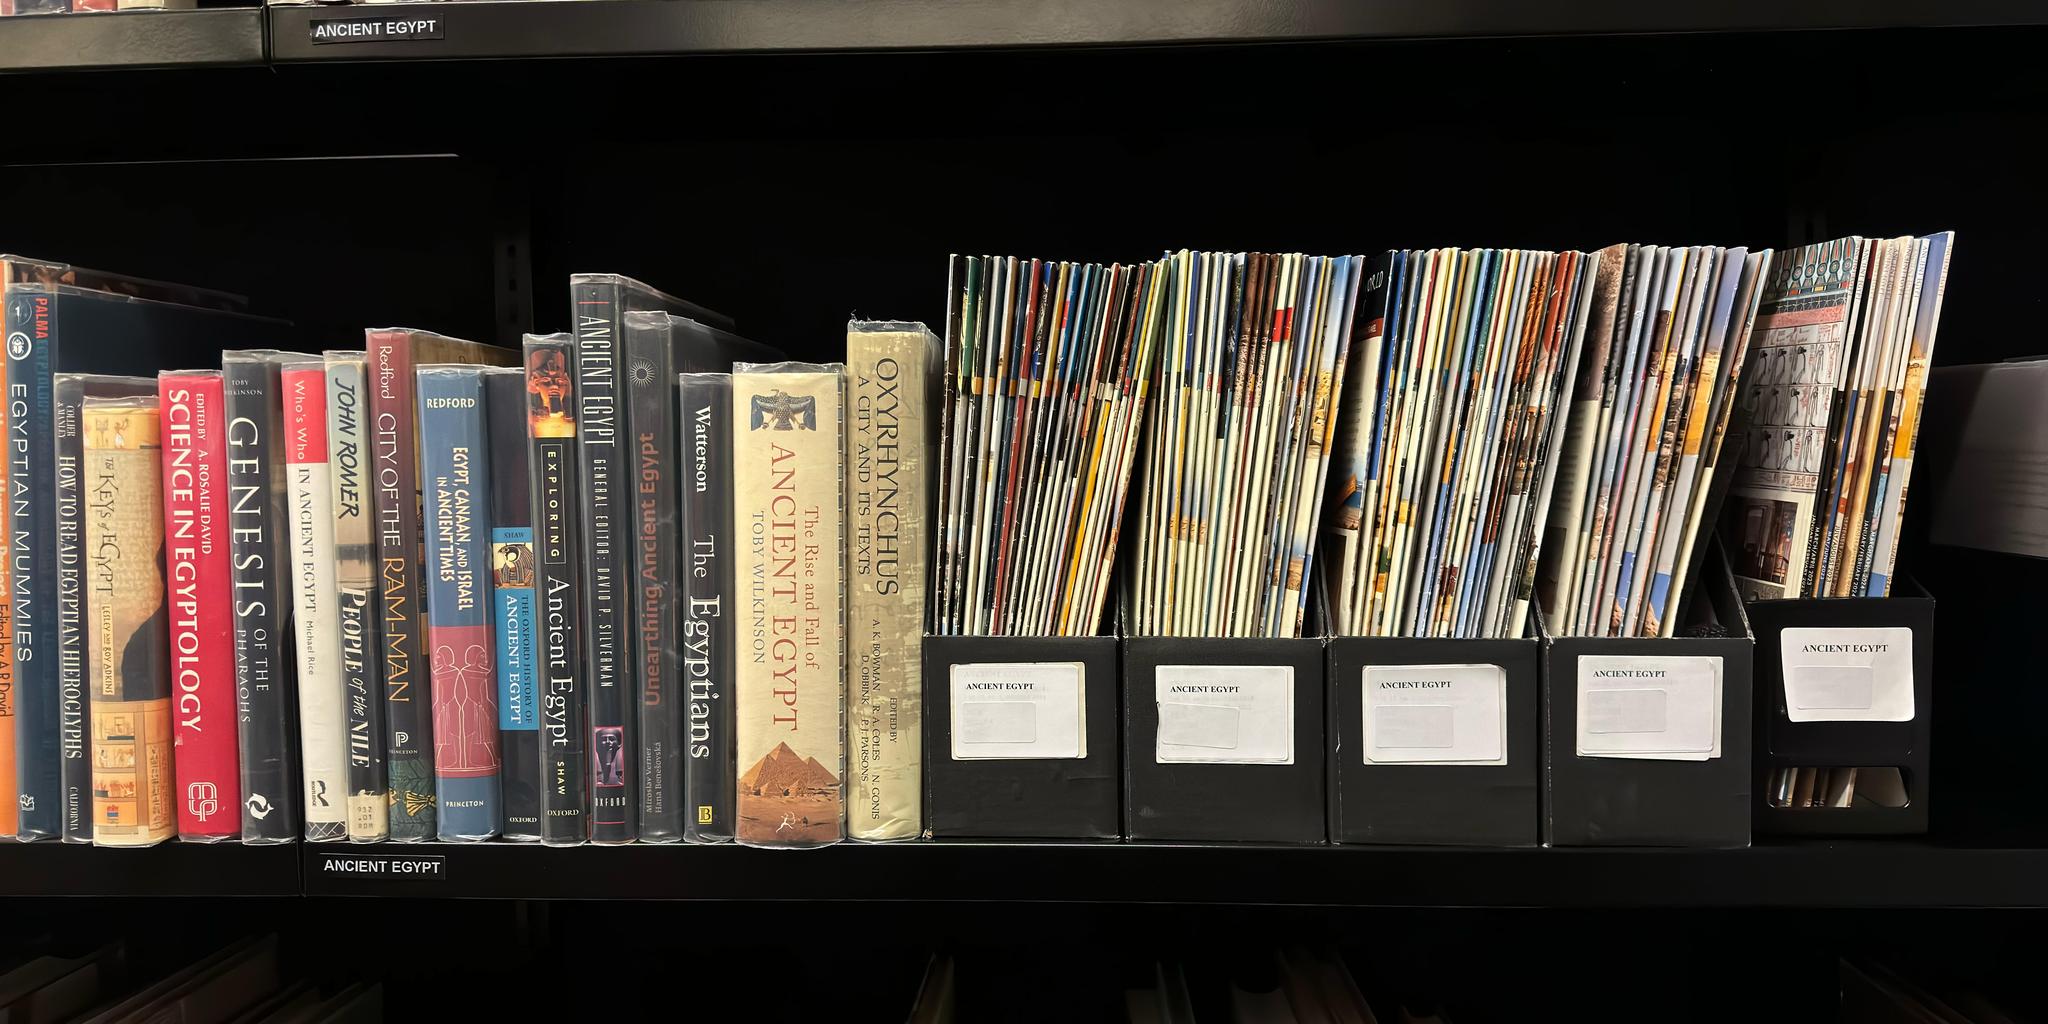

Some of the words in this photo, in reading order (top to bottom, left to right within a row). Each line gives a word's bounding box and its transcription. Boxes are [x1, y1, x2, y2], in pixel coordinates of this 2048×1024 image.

[315, 22, 382, 37] ANCIENT
[386, 20, 436, 35] EGYPT
[35, 298, 48, 339] PALMA
[379, 345, 396, 399] Redford
[580, 315, 613, 389] ANCIENT
[294, 380, 306, 423] Who's
[858, 376, 870, 388] A
[65, 405, 76, 437] COLLIER
[196, 393, 206, 427] EDITED
[335, 378, 356, 436] JOHN
[427, 398, 475, 408] REDFORD
[582, 396, 615, 448] EGYPT
[858, 396, 871, 435] CITY
[12, 384, 30, 517] EGYPTIAN
[168, 389, 193, 502] SCIENCE
[198, 429, 207, 441] BY
[198, 449, 209, 461] A.
[296, 427, 308, 460] Who
[378, 413, 398, 465] CITY
[695, 405, 711, 492] Watterson
[59, 456, 77, 491] HOW
[298, 468, 310, 484] IN
[336, 441, 360, 520] ROMER
[436, 477, 447, 487] IN
[452, 447, 469, 487] EGYPT,
[594, 459, 608, 507] GENERAL
[639, 433, 660, 493] Egypt
[858, 443, 871, 483] AND
[876, 357, 899, 596] OXYRHYNCHUS
[90, 474, 119, 518] KEYS
[199, 464, 211, 513] ROSALIE
[380, 468, 399, 500] OF
[547, 451, 560, 557] EXPLORING
[858, 492, 871, 516] ITS
[60, 495, 77, 519] TO
[173, 510, 195, 538] IN
[228, 417, 266, 617] GENESIS
[299, 489, 314, 558] ANCIENT
[382, 503, 401, 547] THE
[437, 489, 452, 548] ANCIENT
[453, 489, 471, 545] CANAAN,
[771, 442, 798, 604] ANCIENT
[804, 506, 820, 538] The
[60, 521, 78, 564] READ
[201, 515, 212, 554] DAVID
[595, 515, 610, 561] EDITOR:
[641, 499, 661, 578] Ancient
[752, 510, 765, 561] TOBY
[858, 524, 871, 575] TEXTS
[91, 533, 120, 597] EGYPT
[439, 547, 455, 582] TIMES
[456, 548, 467, 567] AND
[693, 534, 714, 578] The
[804, 544, 820, 577] Rise
[15, 531, 32, 662] MUMMIES
[302, 562, 317, 613] EGYPT
[457, 570, 474, 610] ISRAEL
[597, 568, 610, 601] DAVID
[804, 583, 820, 611] and
[61, 569, 80, 646] EGYPTIAN
[102, 606, 113, 632] LESLEY
[520, 594, 530, 616] THE
[547, 575, 571, 668] Ancient
[598, 608, 611, 618] P.
[752, 563, 765, 664] WILKINSON
[872, 619, 880, 630] A.
[175, 547, 202, 732] EGYPTOLOGY
[254, 628, 268, 650] OF
[306, 620, 316, 654] Michael
[342, 587, 370, 673] PEOPLE
[383, 556, 410, 702] RAM-MAN
[506, 594, 521, 668] ANCIENT
[522, 618, 532, 661] OXFORD
[642, 586, 662, 706] Unearthing
[804, 617, 820, 648] Fall
[872, 632, 880, 642] K.
[1801, 645, 1850, 653] ANCIENT
[1853, 645, 1888, 653] EGYPT
[255, 657, 269, 692] THE
[306, 656, 316, 676] Rice
[599, 624, 614, 688] SILVERMAN
[773, 615, 798, 731] EGYPT
[805, 652, 820, 671] of
[861, 655, 870, 665] D.
[872, 643, 881, 691] BOWMAN
[1593, 670, 1634, 678] ANCIENT
[104, 663, 114, 693] ADKINS
[237, 629, 251, 724] PHARAOHS
[349, 677, 367, 692] of
[523, 663, 533, 708] HISTORY
[685, 594, 720, 759] Egyptians
[861, 667, 870, 705] OBBINK
[63, 650, 82, 759] HIEROGLYPHS
[352, 696, 368, 716] the
[509, 672, 522, 725] EGYPT
[524, 710, 534, 725] OF
[545, 676, 574, 746] Egypt
[872, 705, 881, 715] R.
[889, 697, 898, 731] EDITED
[872, 717, 881, 727] A.
[889, 731, 898, 744] BY
[350, 719, 370, 768] NILE
[645, 747, 654, 774] Verner
[860, 736, 870, 782] PARSONS
[872, 728, 881, 761] COLES
[557, 761, 566, 795] SHAW
[645, 776, 654, 813] Miroslav
[871, 774, 881, 787] N.
[69, 786, 79, 831] CALIFORNIA
[547, 809, 580, 817] OXFORD
[654, 794, 662, 813] Hana
[871, 787, 881, 820] GONIS
[323, 859, 387, 873] ANCIENT
[391, 861, 440, 874] EGYPT
